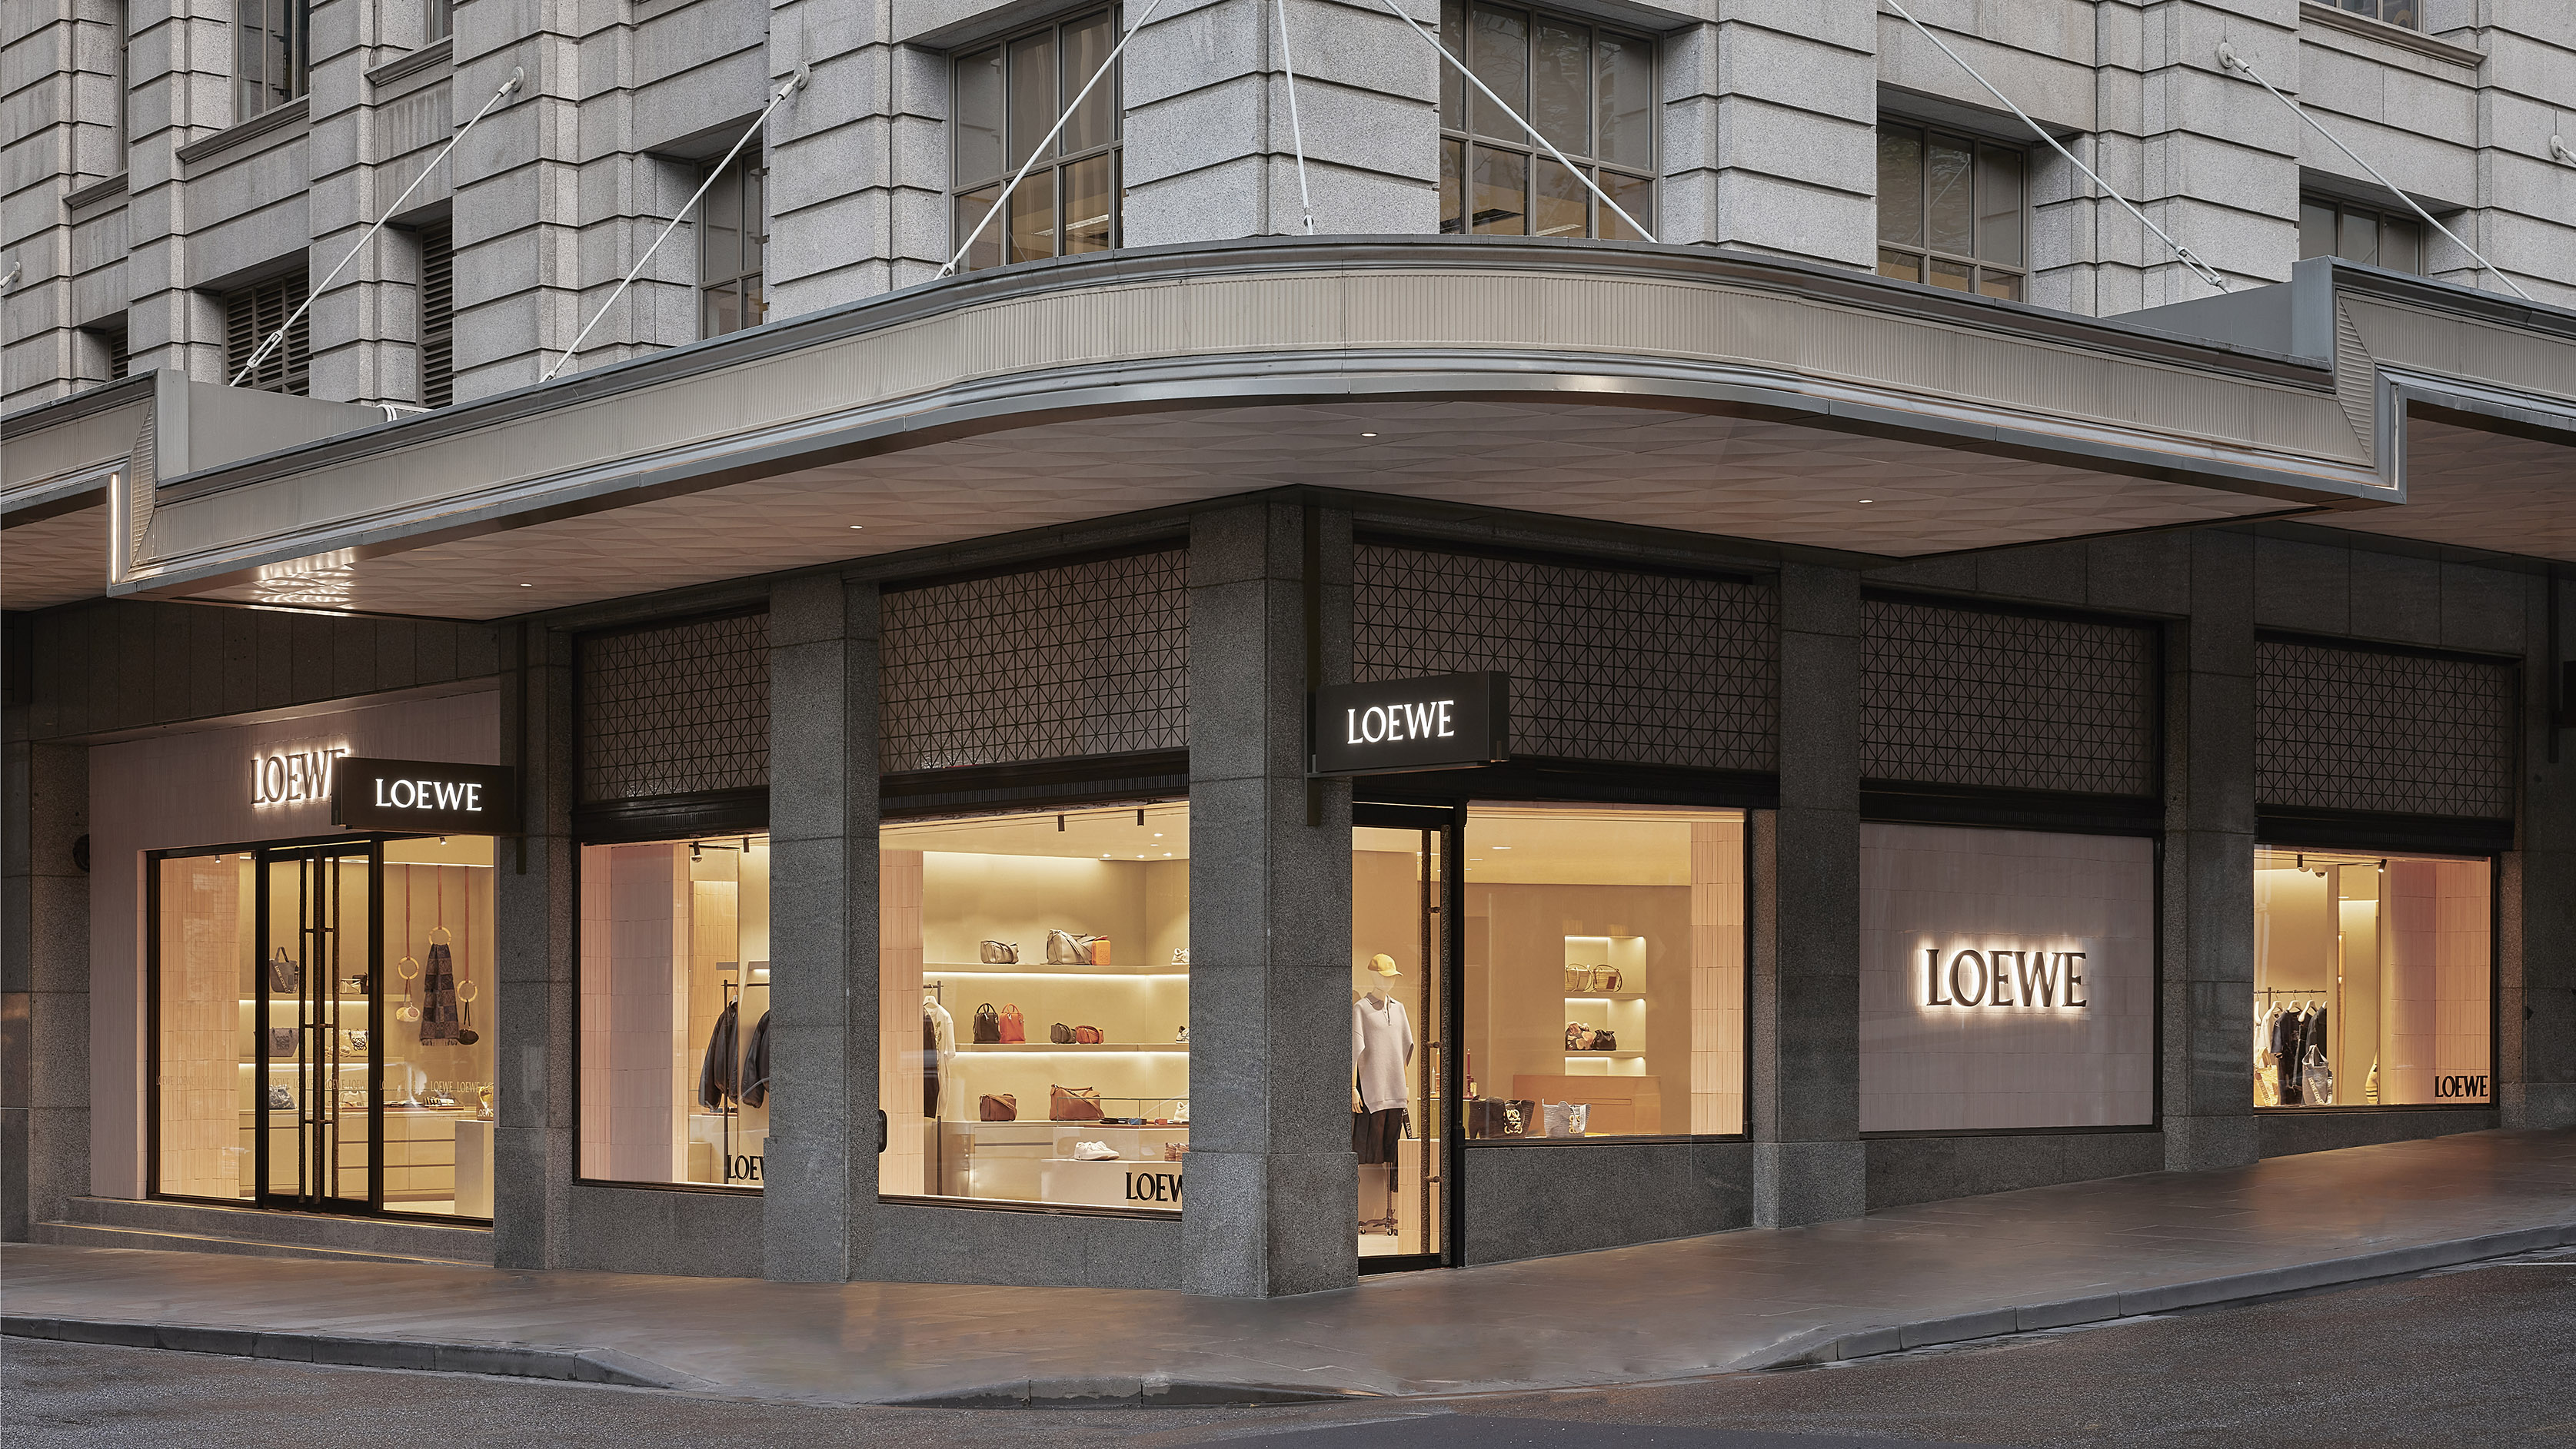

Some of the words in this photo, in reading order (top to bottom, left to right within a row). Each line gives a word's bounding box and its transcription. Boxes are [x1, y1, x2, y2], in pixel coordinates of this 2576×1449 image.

[1347, 700, 1455, 744] LOEWE
[251, 749, 346, 804] LOEW
[375, 778, 482, 812] LOEWE
[1926, 949, 2086, 1007] LOEWE
[431, 1081, 453, 1092] LOEWE
[457, 1082, 480, 1093] LOEWE
[2435, 1075, 2488, 1097] LOEWE
